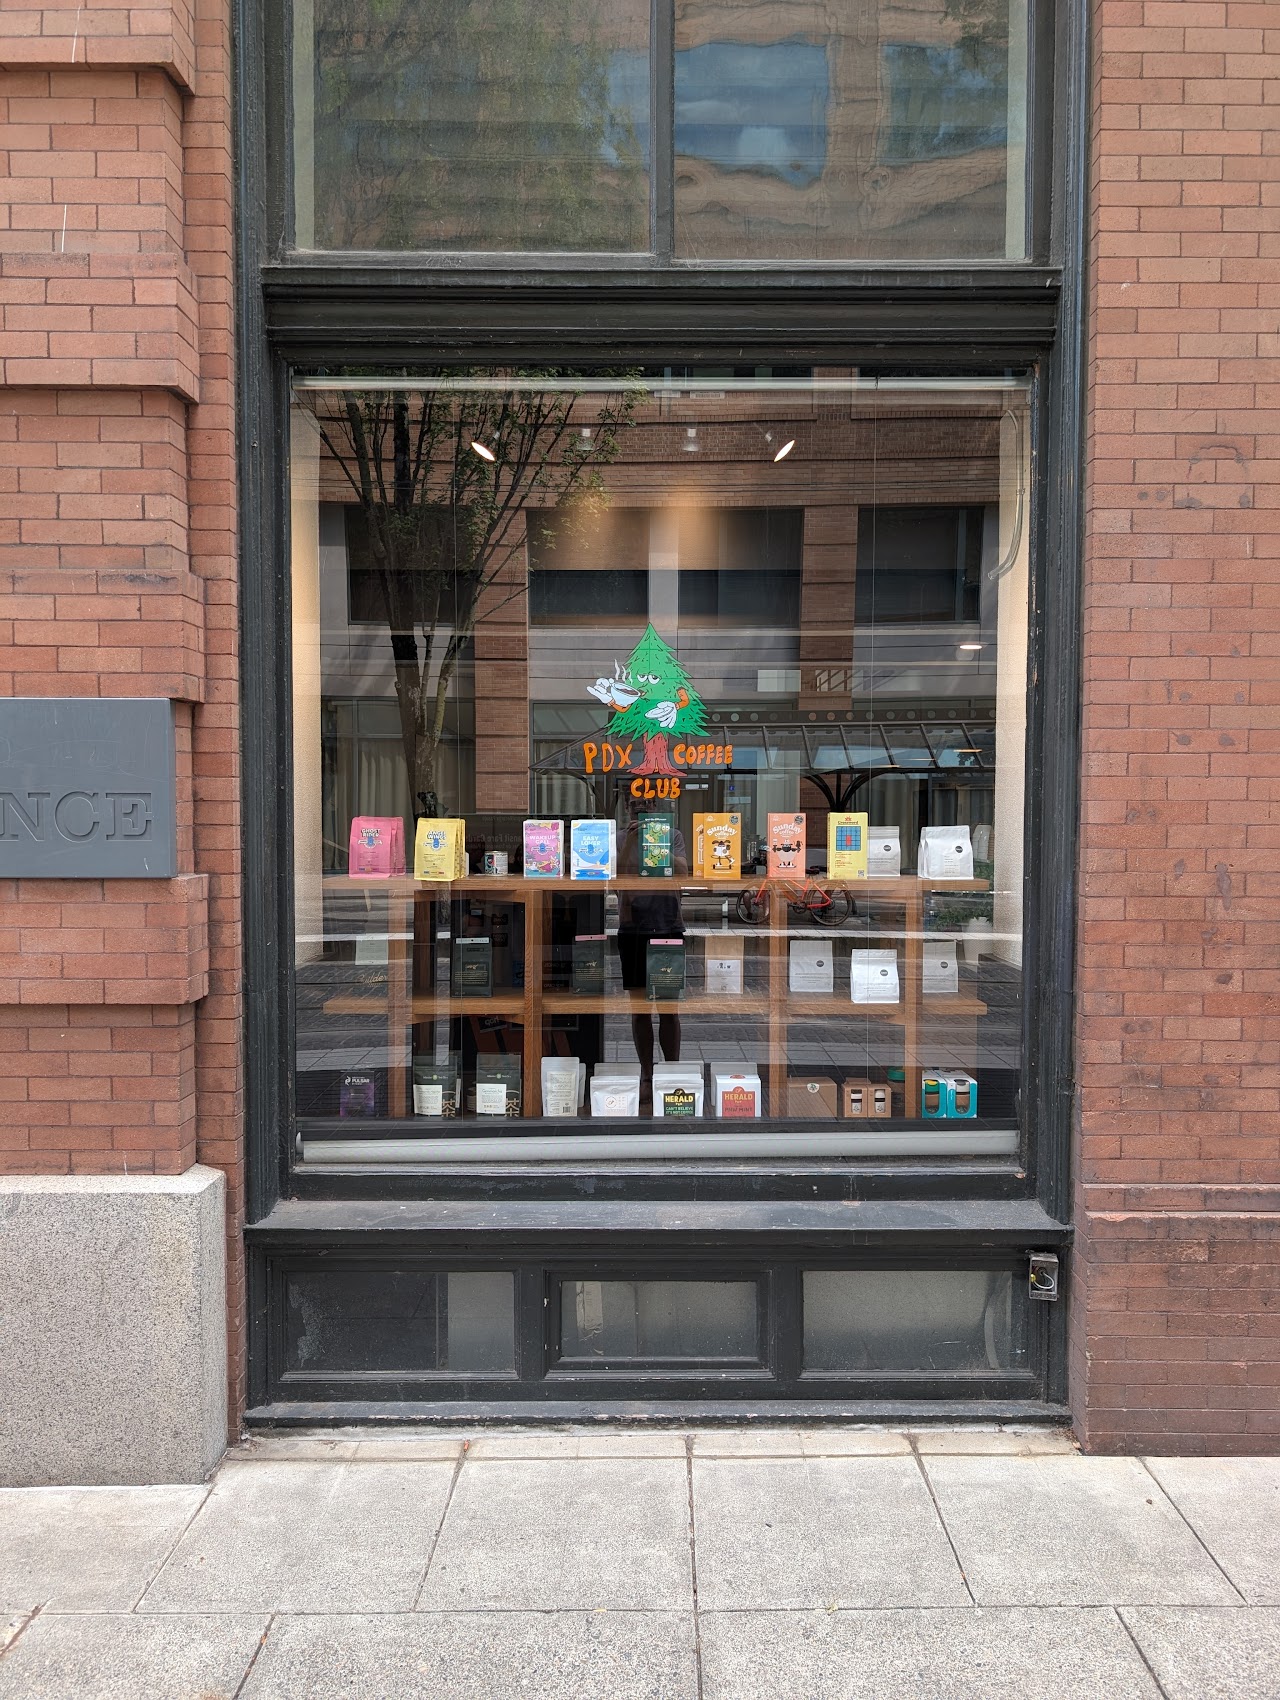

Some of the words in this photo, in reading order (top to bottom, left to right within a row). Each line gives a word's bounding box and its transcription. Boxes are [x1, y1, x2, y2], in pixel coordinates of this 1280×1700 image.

[583, 742, 633, 773] PDX
[673, 743, 733, 765] COFFEE
[630, 777, 681, 799] CLUB
[0, 791, 152, 843] NCE
[706, 824, 738, 837] Sunday
[772, 822, 803, 834] Sunday
[665, 1095, 694, 1103] HERALD
[724, 1093, 753, 1101] HERALD
